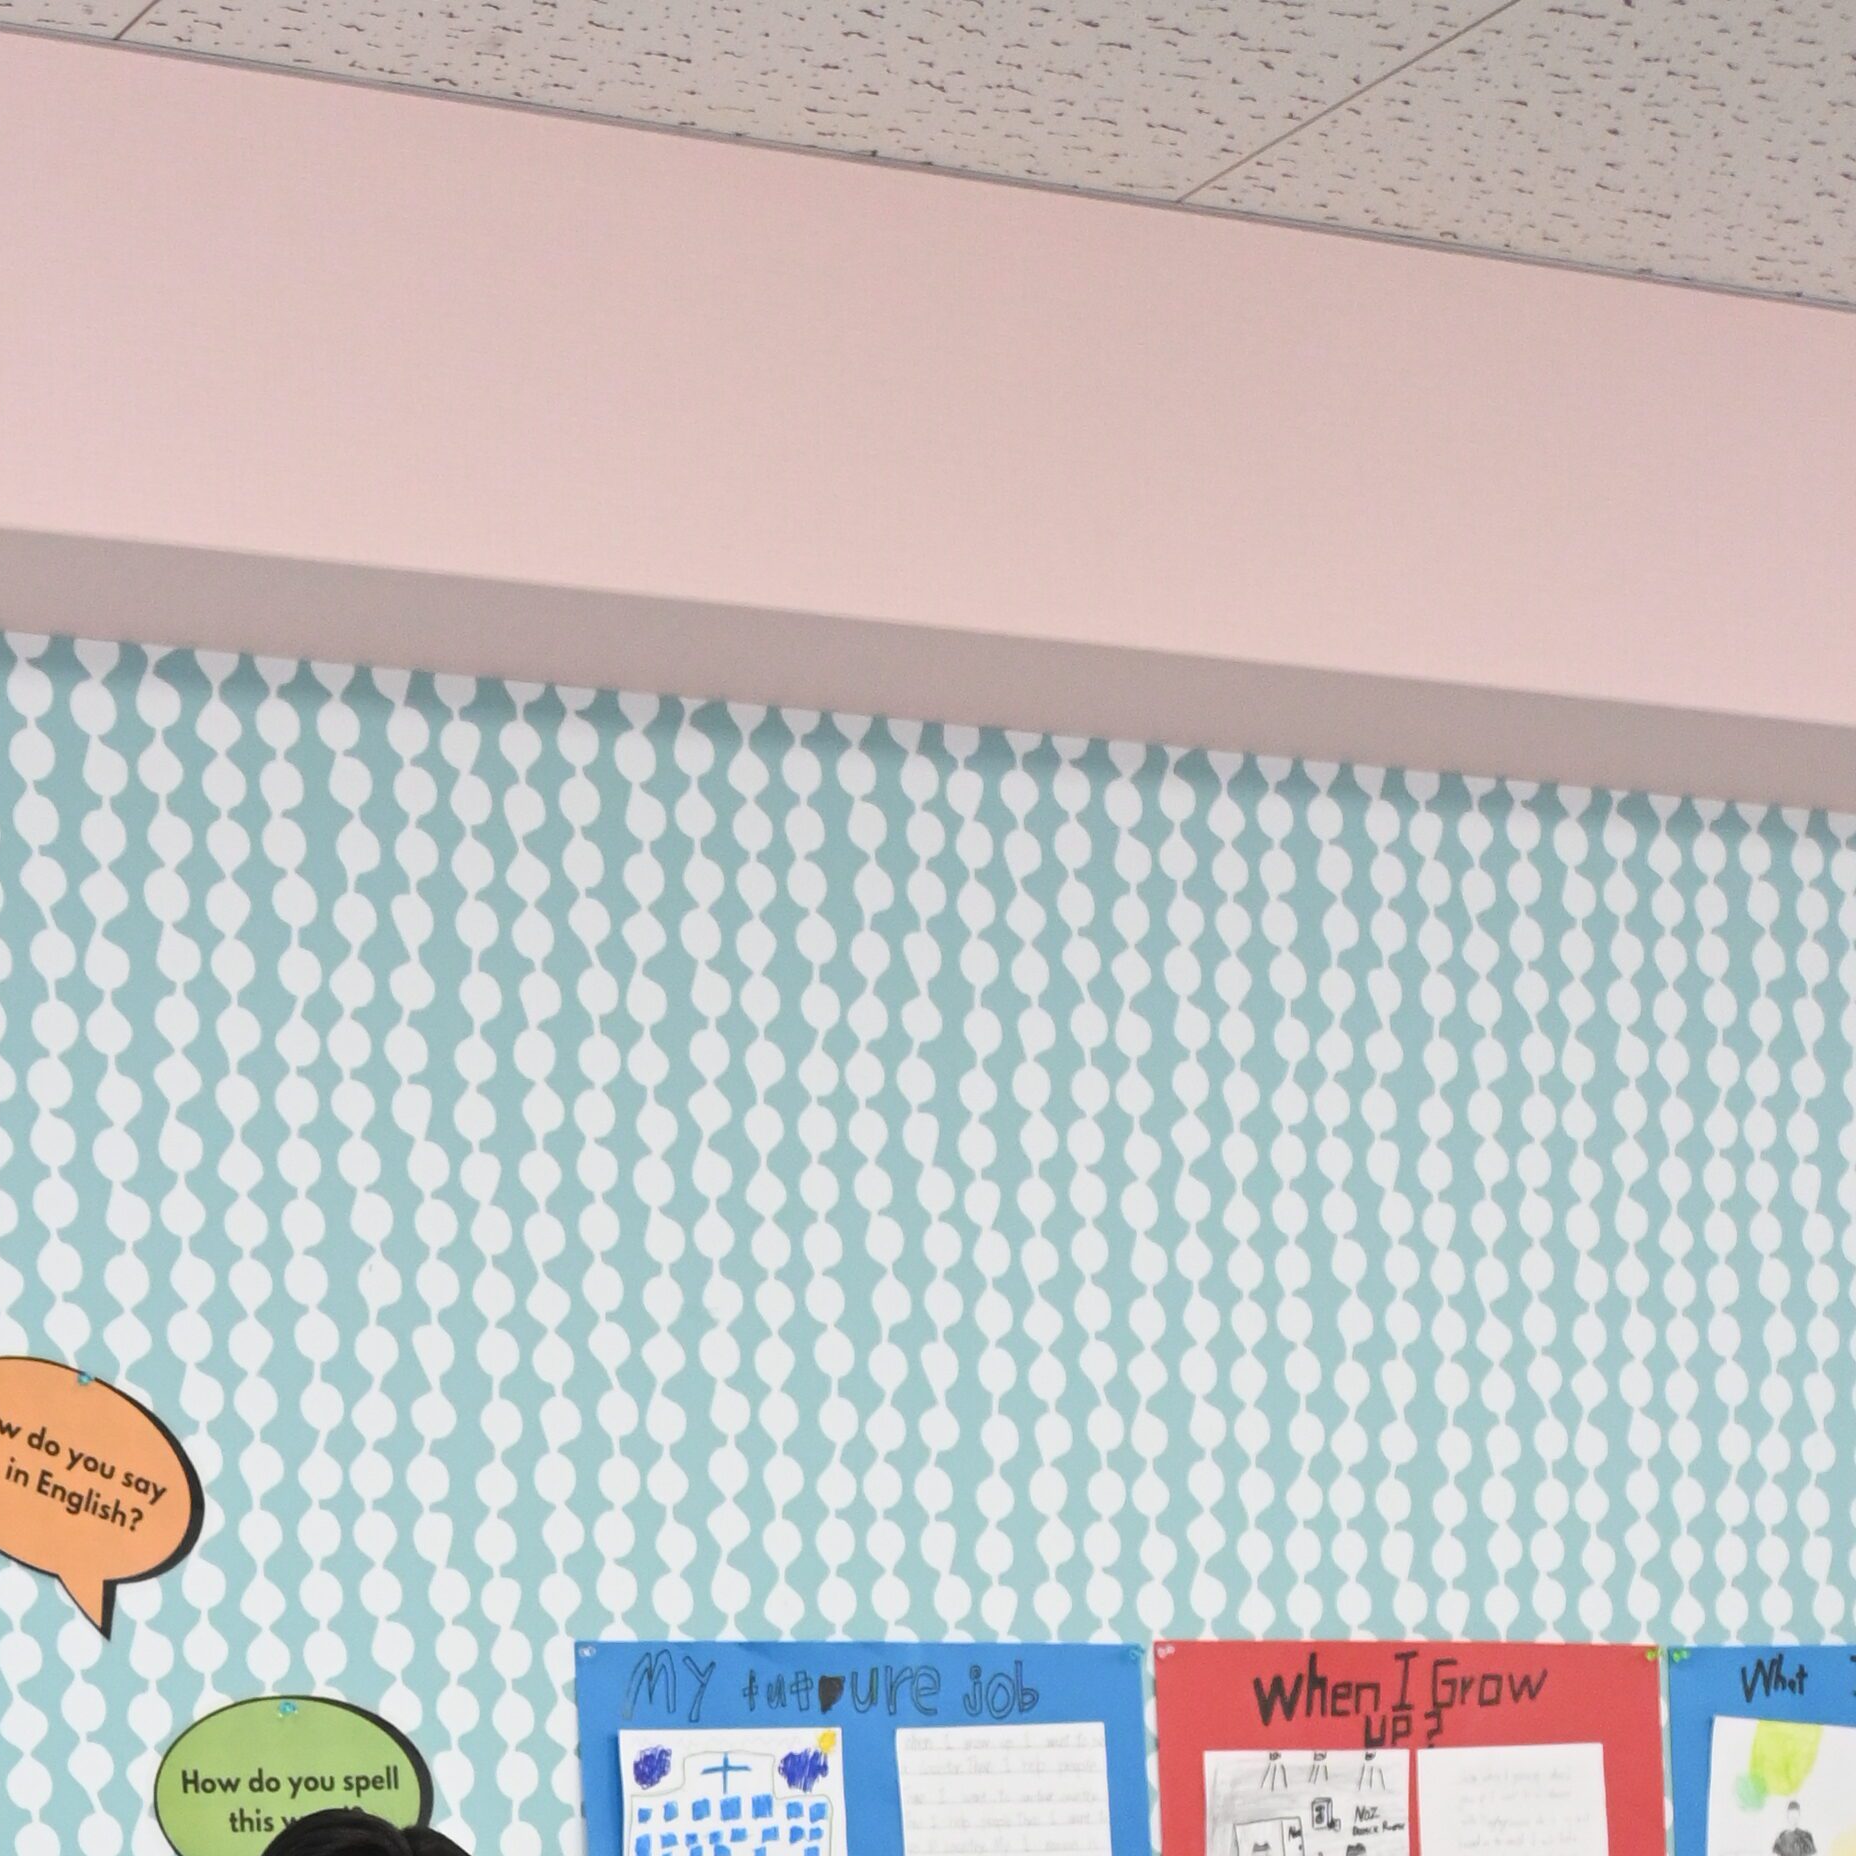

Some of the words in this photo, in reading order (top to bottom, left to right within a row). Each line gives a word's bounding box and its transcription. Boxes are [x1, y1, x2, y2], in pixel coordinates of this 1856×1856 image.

[5, 1456, 30, 1488] in
[36, 1469, 144, 1532] English?
[27, 1426, 61, 1457] do
[65, 1447, 116, 1480] you
[121, 1471, 168, 1506] say
[963, 1660, 1040, 1720] job
[1254, 1653, 1381, 1726] When
[1392, 1650, 1419, 1712] I
[1431, 1657, 1548, 1709] Grow
[1741, 1653, 1808, 1703] What
[181, 1769, 241, 1794] How
[248, 1767, 281, 1793] do
[287, 1775, 335, 1799] you
[343, 1765, 399, 1798] spell
[229, 1807, 274, 1833] this
